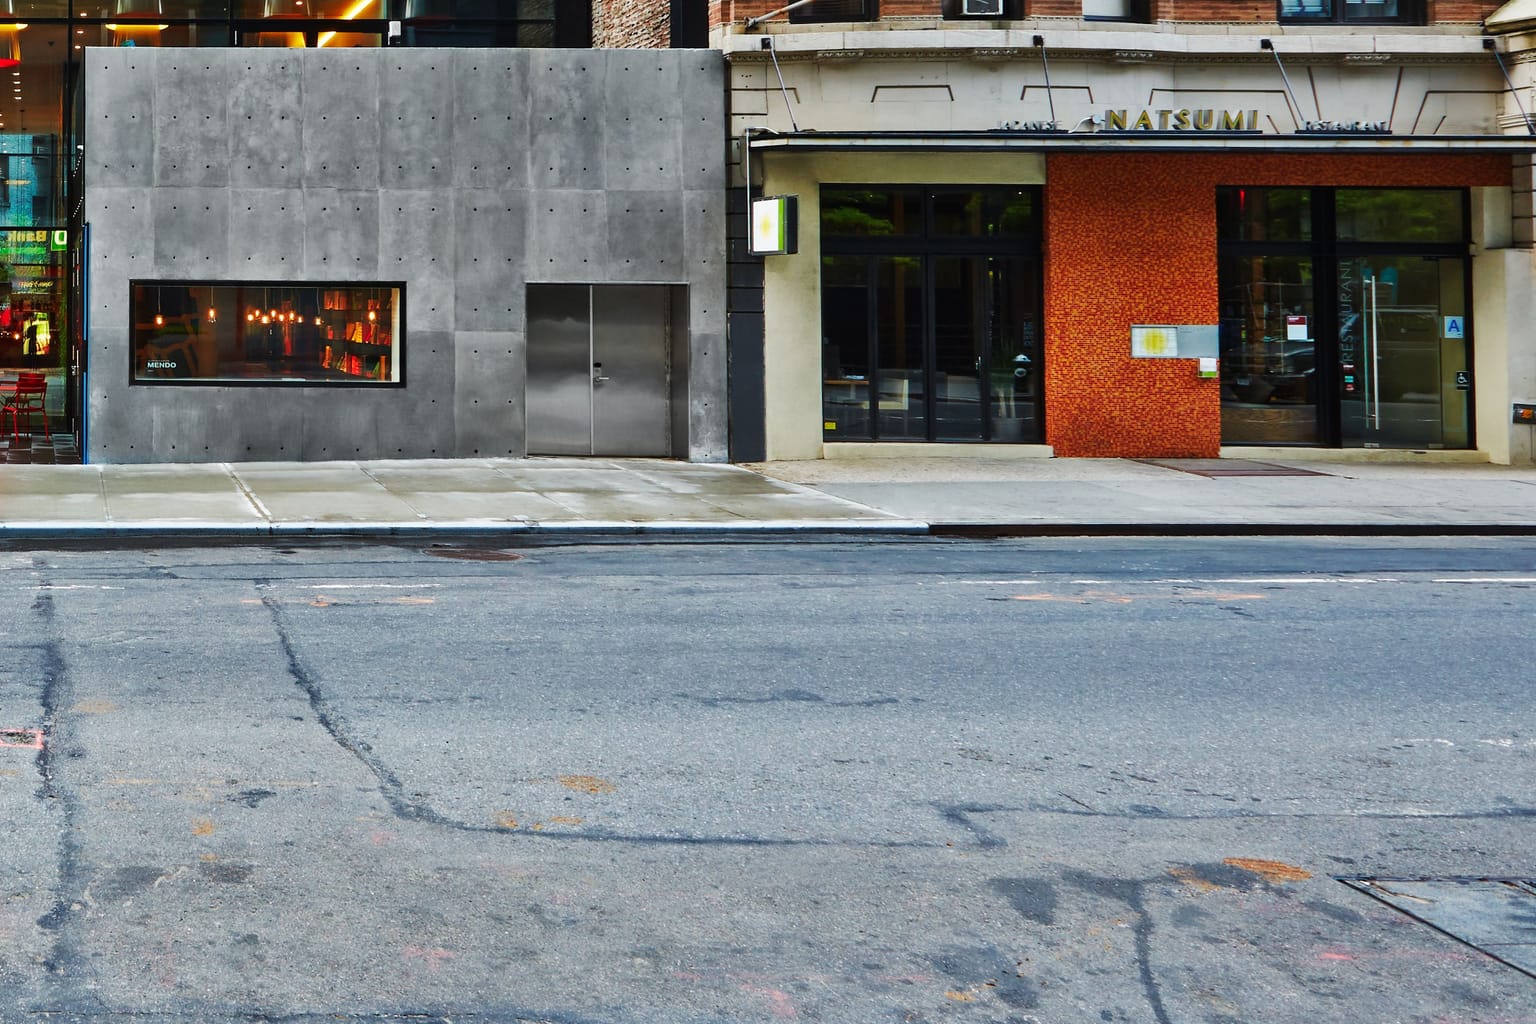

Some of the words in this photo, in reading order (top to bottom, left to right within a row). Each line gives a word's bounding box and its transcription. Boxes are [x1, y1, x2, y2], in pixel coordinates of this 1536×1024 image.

[1105, 109, 1259, 130] NATSUMI
[1447, 319, 1460, 332] A
[147, 361, 177, 369] MENDO
